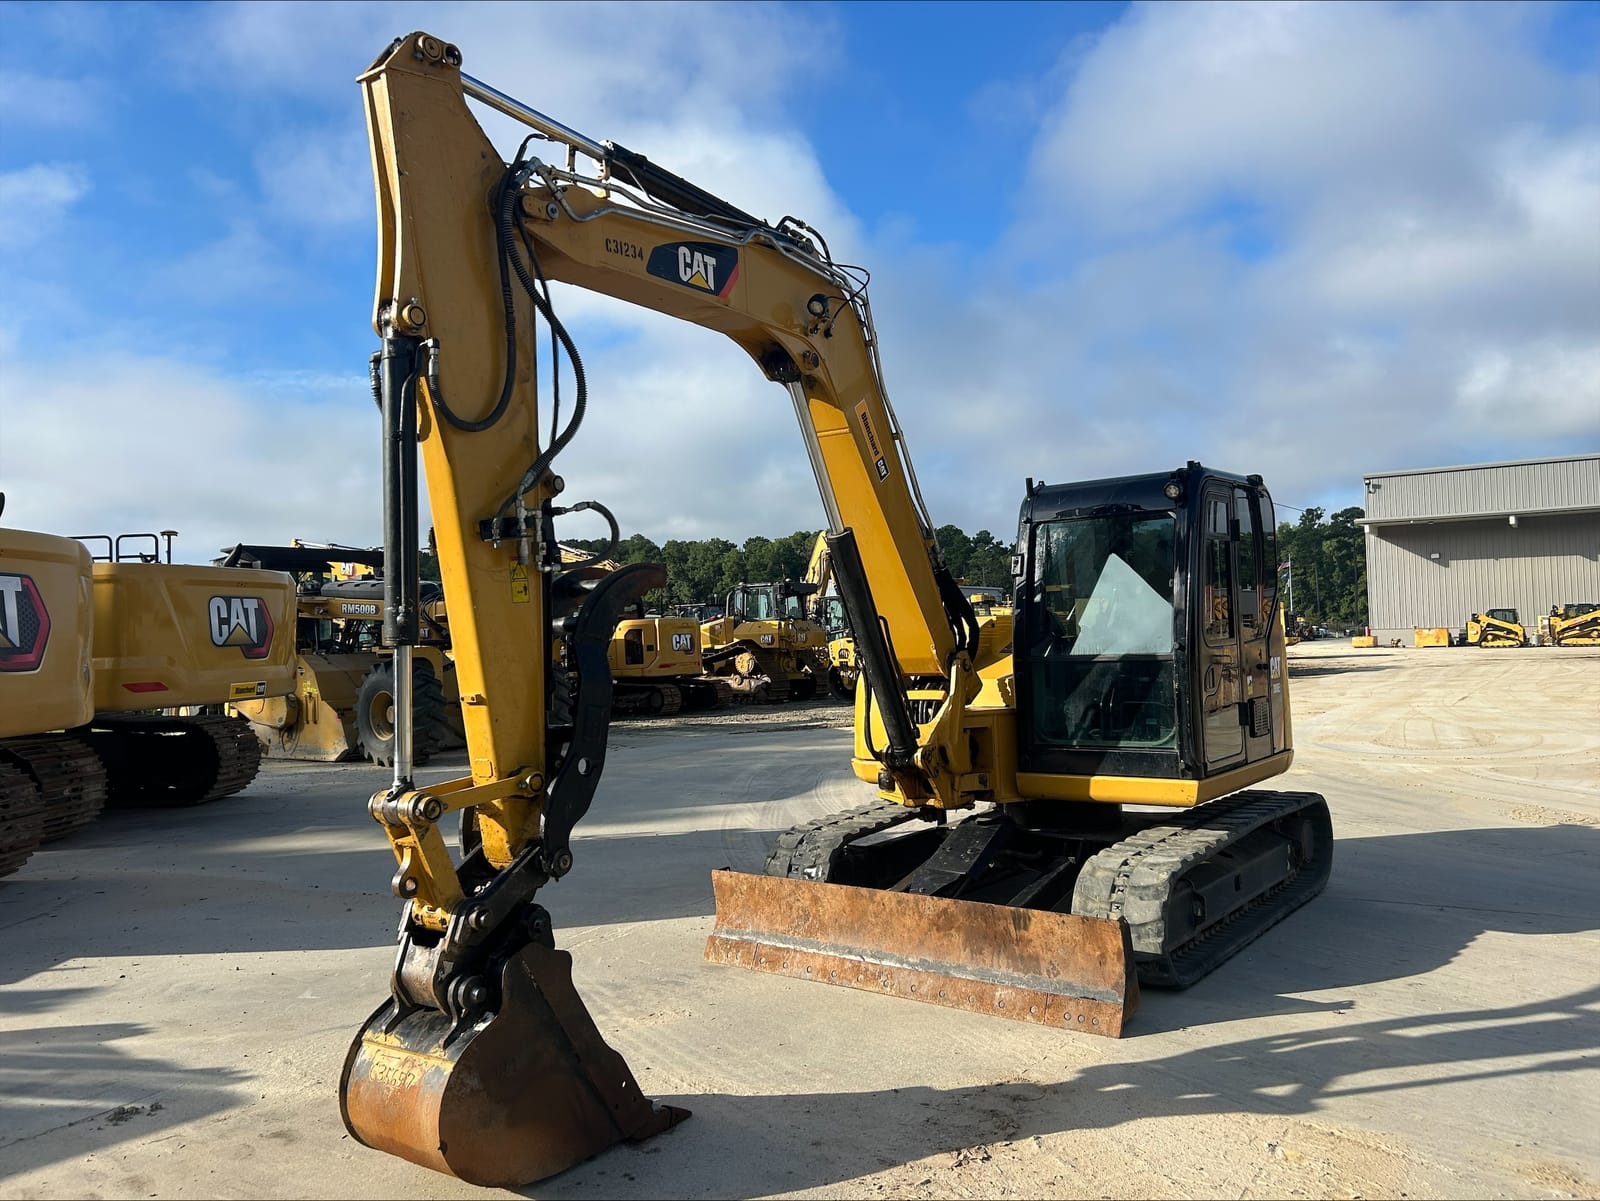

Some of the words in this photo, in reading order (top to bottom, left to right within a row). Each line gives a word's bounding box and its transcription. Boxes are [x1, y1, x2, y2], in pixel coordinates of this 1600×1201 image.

[605, 238, 644, 261] C31234
[678, 245, 717, 291] CAT
[861, 411, 880, 457] Blanchard
[340, 562, 354, 576] CAT
[341, 603, 377, 615] RM500B
[209, 596, 259, 646] CAT
[672, 633, 692, 651] CAT
[760, 634, 772, 644] CAT
